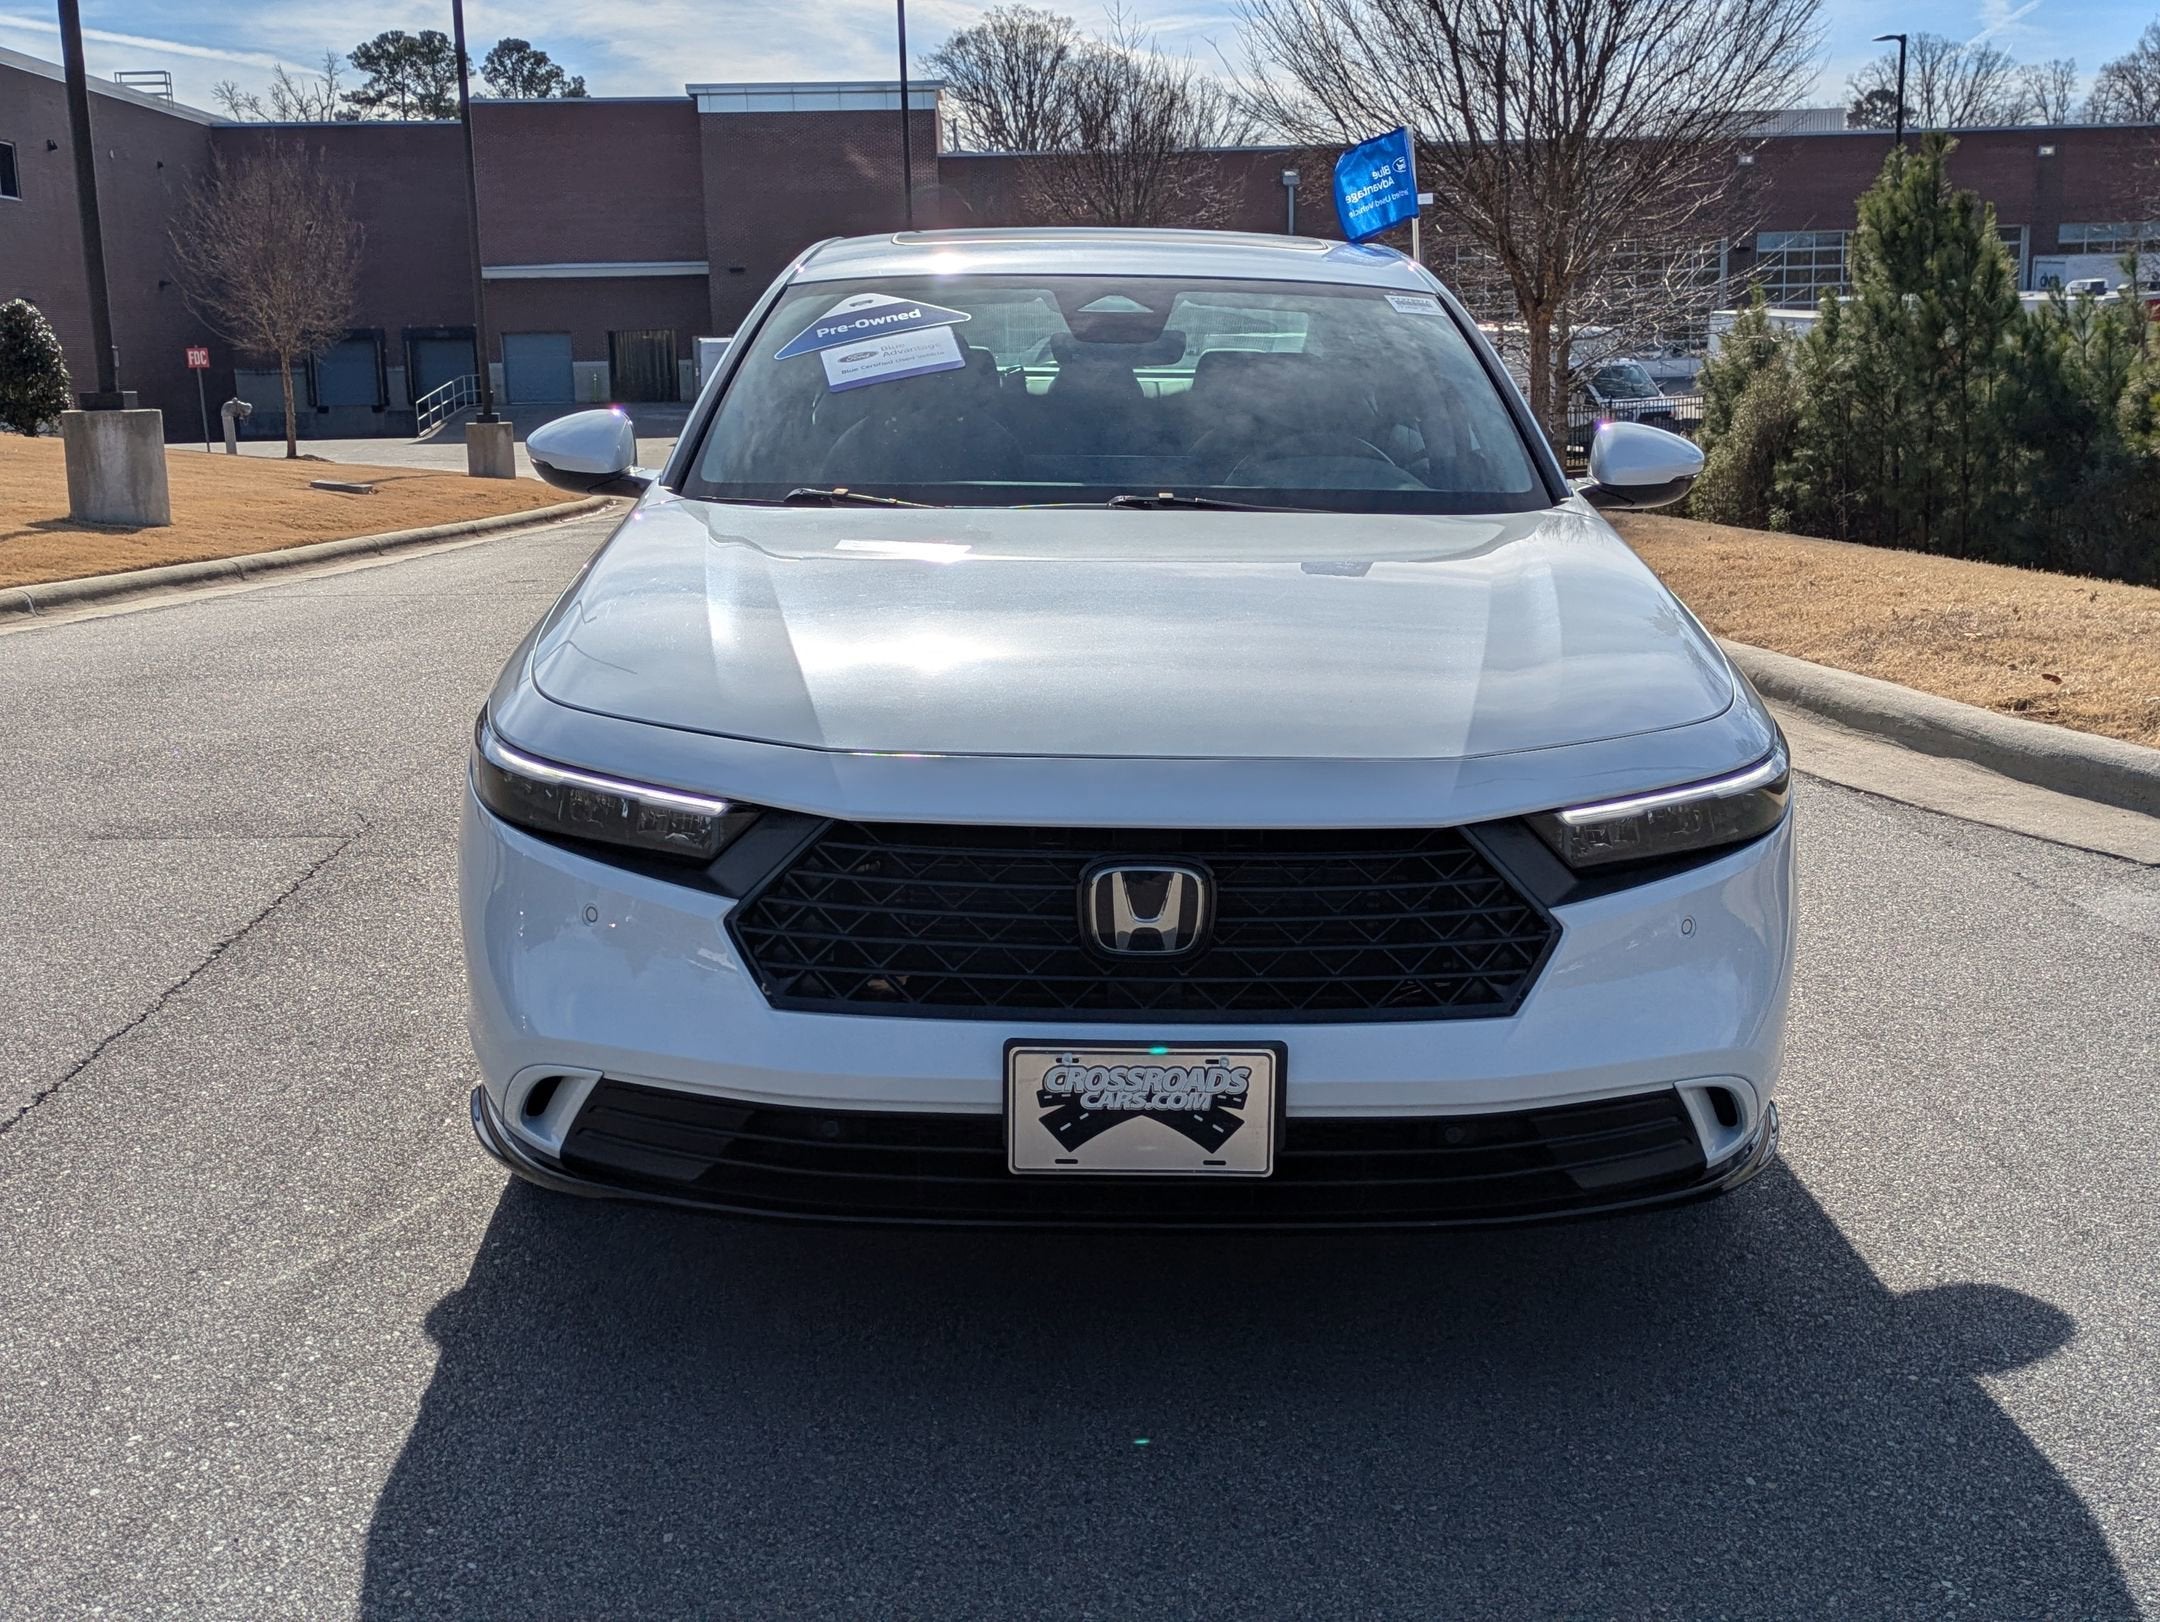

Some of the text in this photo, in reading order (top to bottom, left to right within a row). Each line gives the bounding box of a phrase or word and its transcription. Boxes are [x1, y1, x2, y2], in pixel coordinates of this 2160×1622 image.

[816, 309, 921, 337] Pre-Owned
[188, 351, 207, 365] FDC
[841, 367, 859, 375] Blue
[1043, 1066, 1252, 1095] CROSSROADS
[1080, 1091, 1213, 1111] CARS.COM
